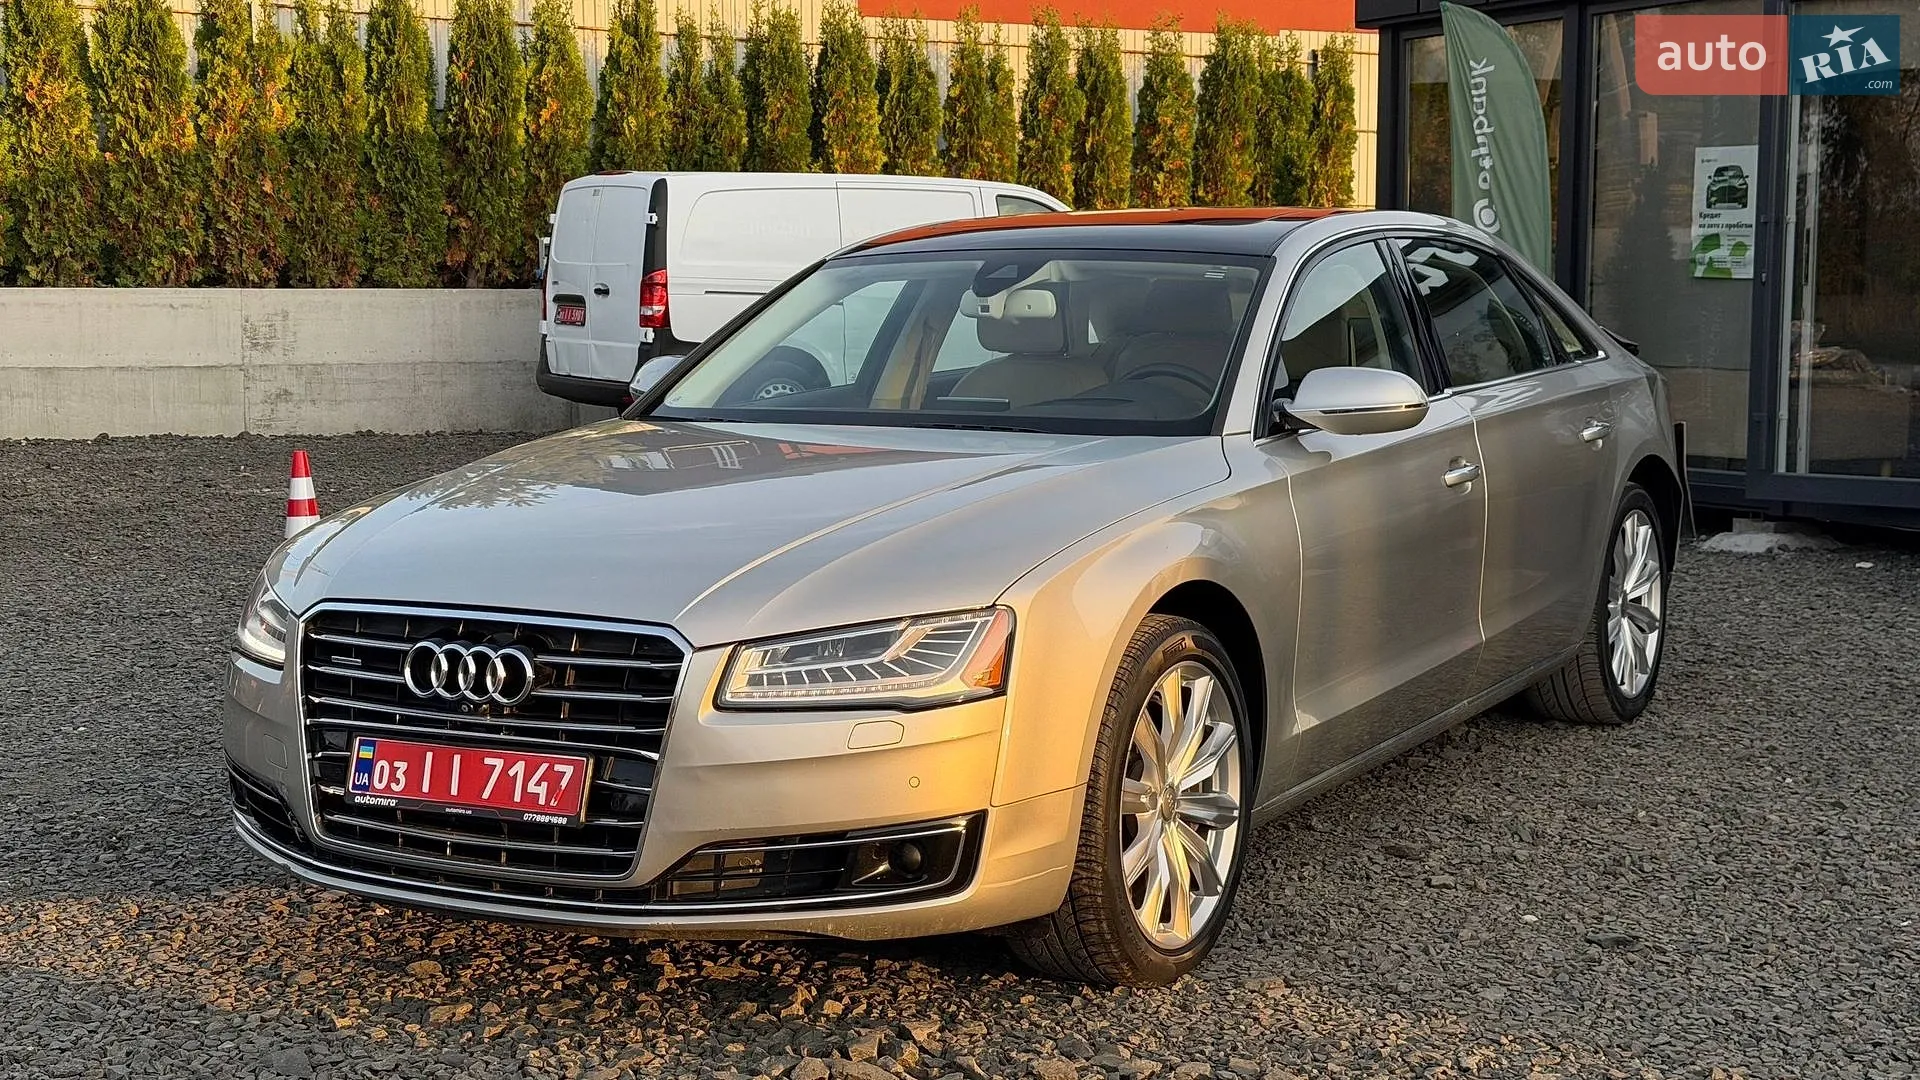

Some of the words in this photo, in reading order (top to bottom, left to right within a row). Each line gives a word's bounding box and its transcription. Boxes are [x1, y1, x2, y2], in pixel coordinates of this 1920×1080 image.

[354, 772, 369, 786] UA
[373, 759, 408, 792] 03
[481, 757, 574, 806] 7147
[354, 795, 396, 807] automira
